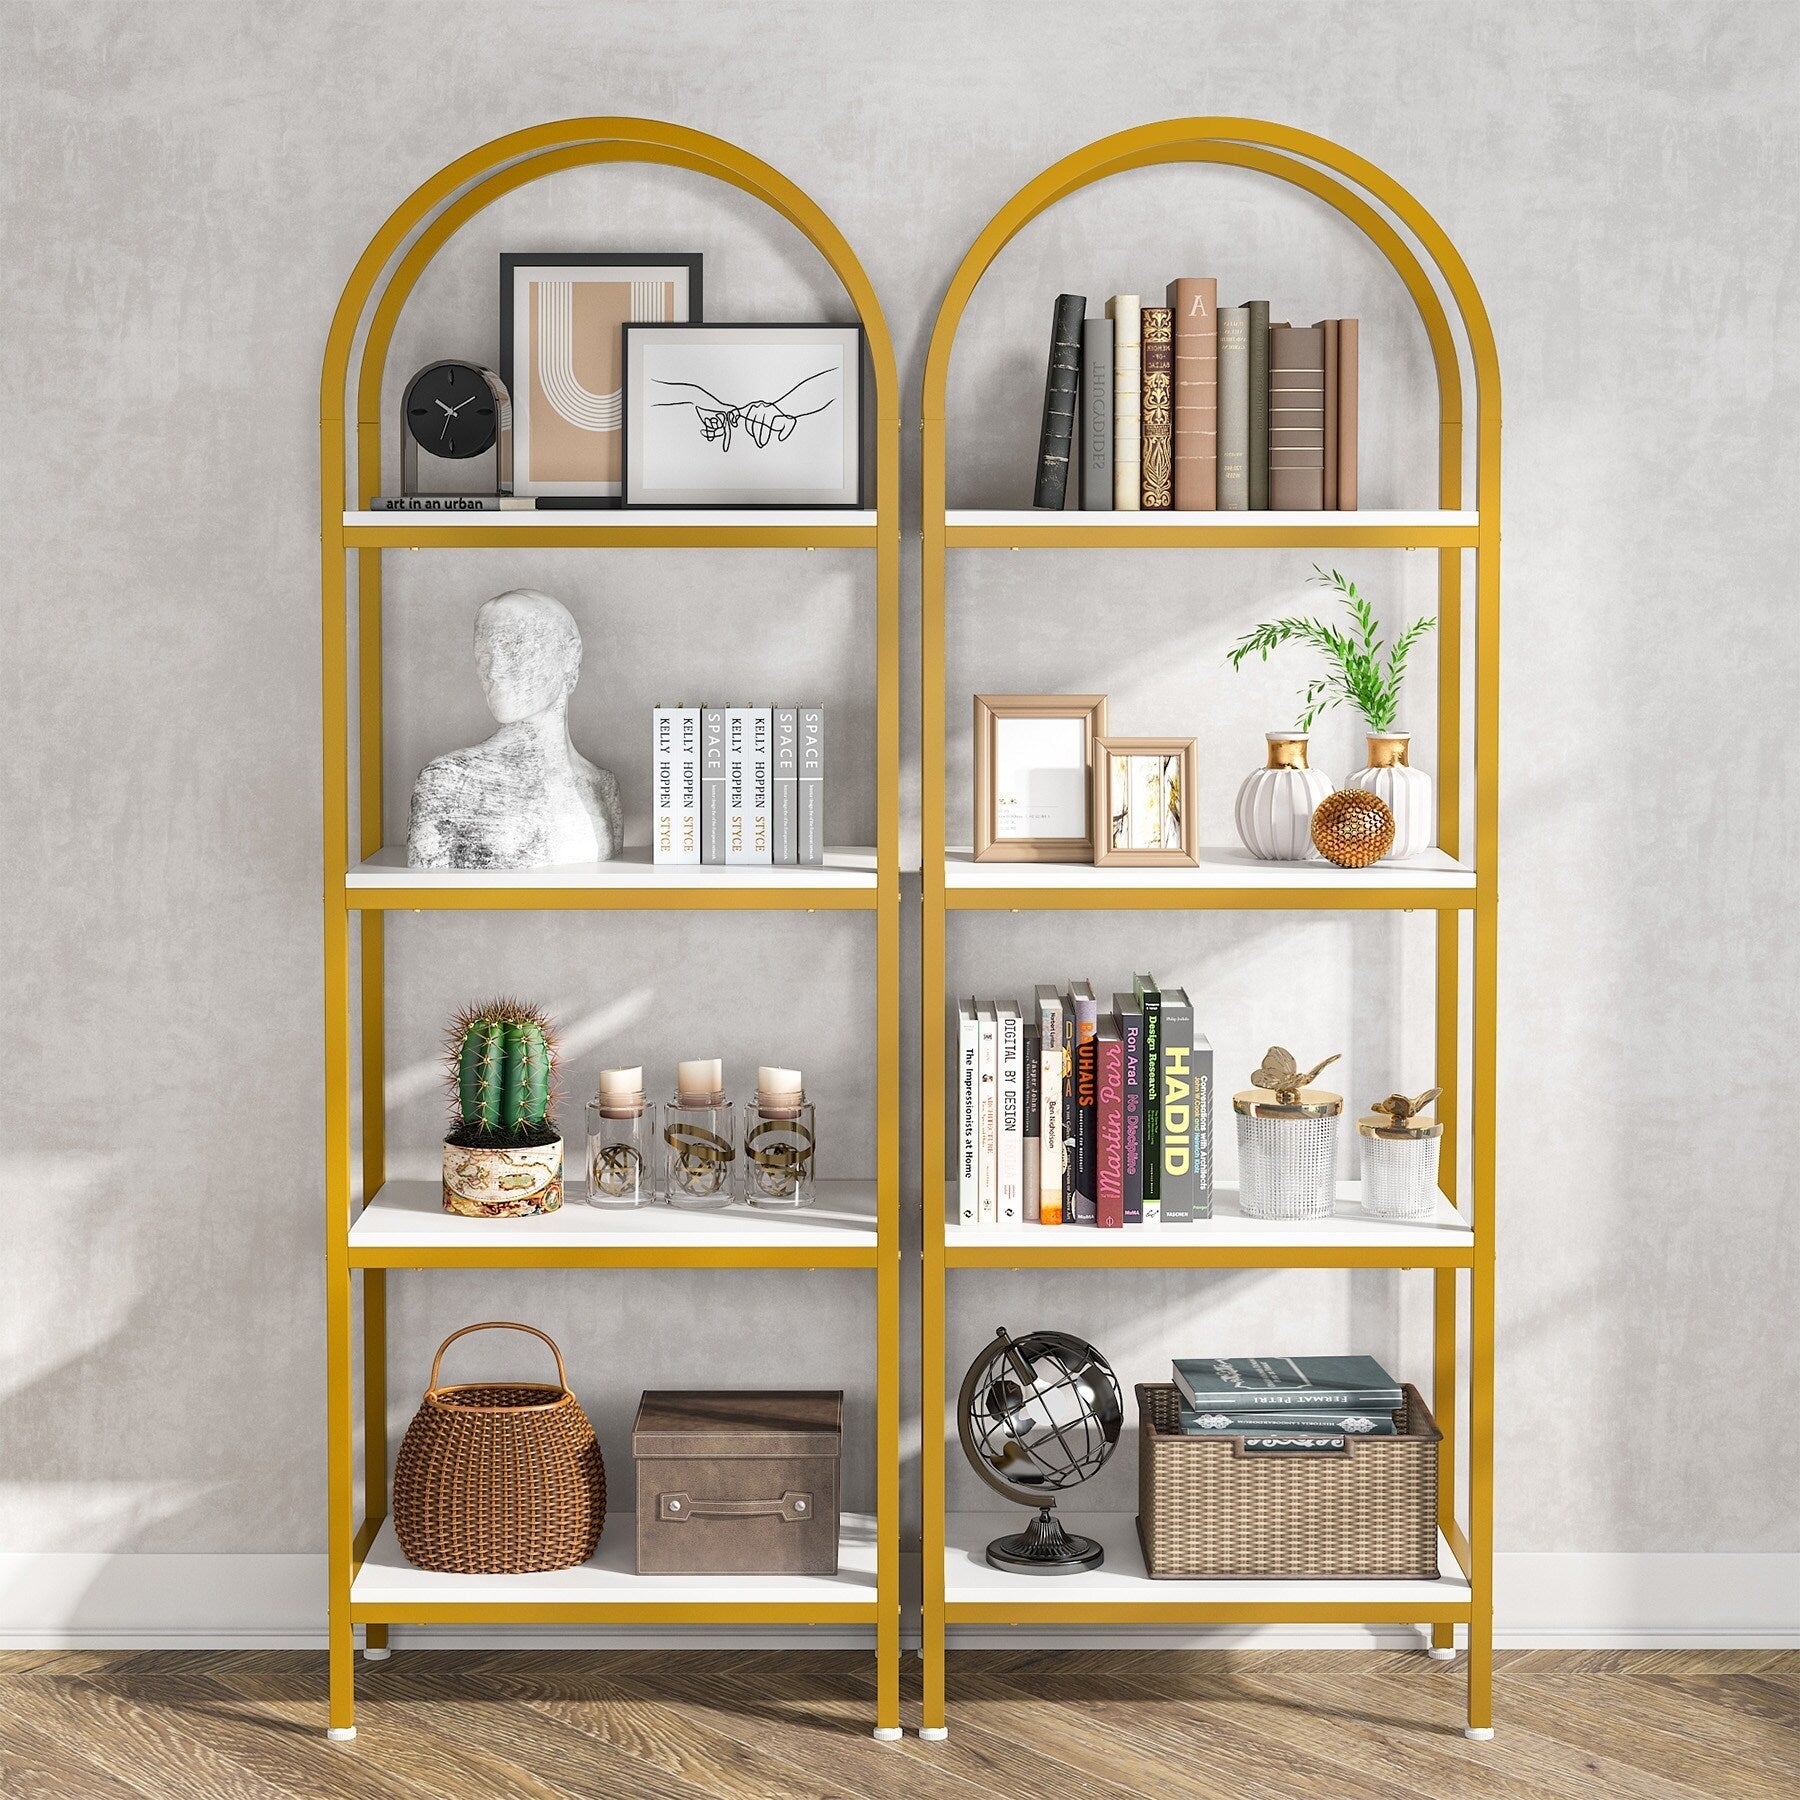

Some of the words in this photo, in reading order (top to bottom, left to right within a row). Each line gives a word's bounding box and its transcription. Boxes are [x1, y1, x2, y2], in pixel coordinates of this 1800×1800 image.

[1188, 295, 1208, 316] A
[386, 498, 405, 509] art
[409, 497, 423, 509] in
[425, 500, 441, 509] an
[444, 498, 483, 509] urban
[660, 718, 670, 753] KELLY
[684, 718, 693, 753] KELLY
[708, 714, 720, 769] SPACE
[732, 718, 741, 753] KELLY
[755, 718, 765, 753] KELLY
[780, 714, 792, 769] SPACE
[805, 714, 818, 769] SPACE
[660, 762, 670, 808] HOPPEN
[684, 762, 693, 808] HOPPEN
[732, 762, 741, 808] HOPPEN
[755, 762, 765, 808] HOPPEN
[660, 816, 670, 852] STYCE
[684, 816, 693, 852] STYCE
[732, 816, 741, 852] STYCE
[755, 816, 765, 852] STYCE
[1004, 1019, 1015, 1063] DIGITAL
[1127, 1027, 1138, 1056] Ron
[1147, 1016, 1158, 1051] Design
[965, 1049, 973, 1065] The
[1030, 1059, 1038, 1086] Jasper
[1078, 1022, 1094, 1107] BAUHAUS
[1127, 1058, 1138, 1085] Arad
[1004, 1071, 1015, 1083] BY
[1148, 1053, 1158, 1100] Research
[964, 1068, 973, 1138] Impressionists
[1004, 1091, 1015, 1132] DESIGN
[1127, 1094, 1138, 1112] No
[1165, 1046, 1190, 1176] HADID
[1199, 1075, 1208, 1134] Conversations
[965, 1141, 973, 1149] at
[1048, 1116, 1056, 1149] Nicholson
[1125, 1115, 1139, 1175] Discipline
[1200, 1136, 1208, 1149] with
[965, 1152, 973, 1178] Home
[1200, 1151, 1208, 1190] Architects
[1254, 1396, 1291, 1404] PETRI
[1297, 1395, 1347, 1404] FERMAT
